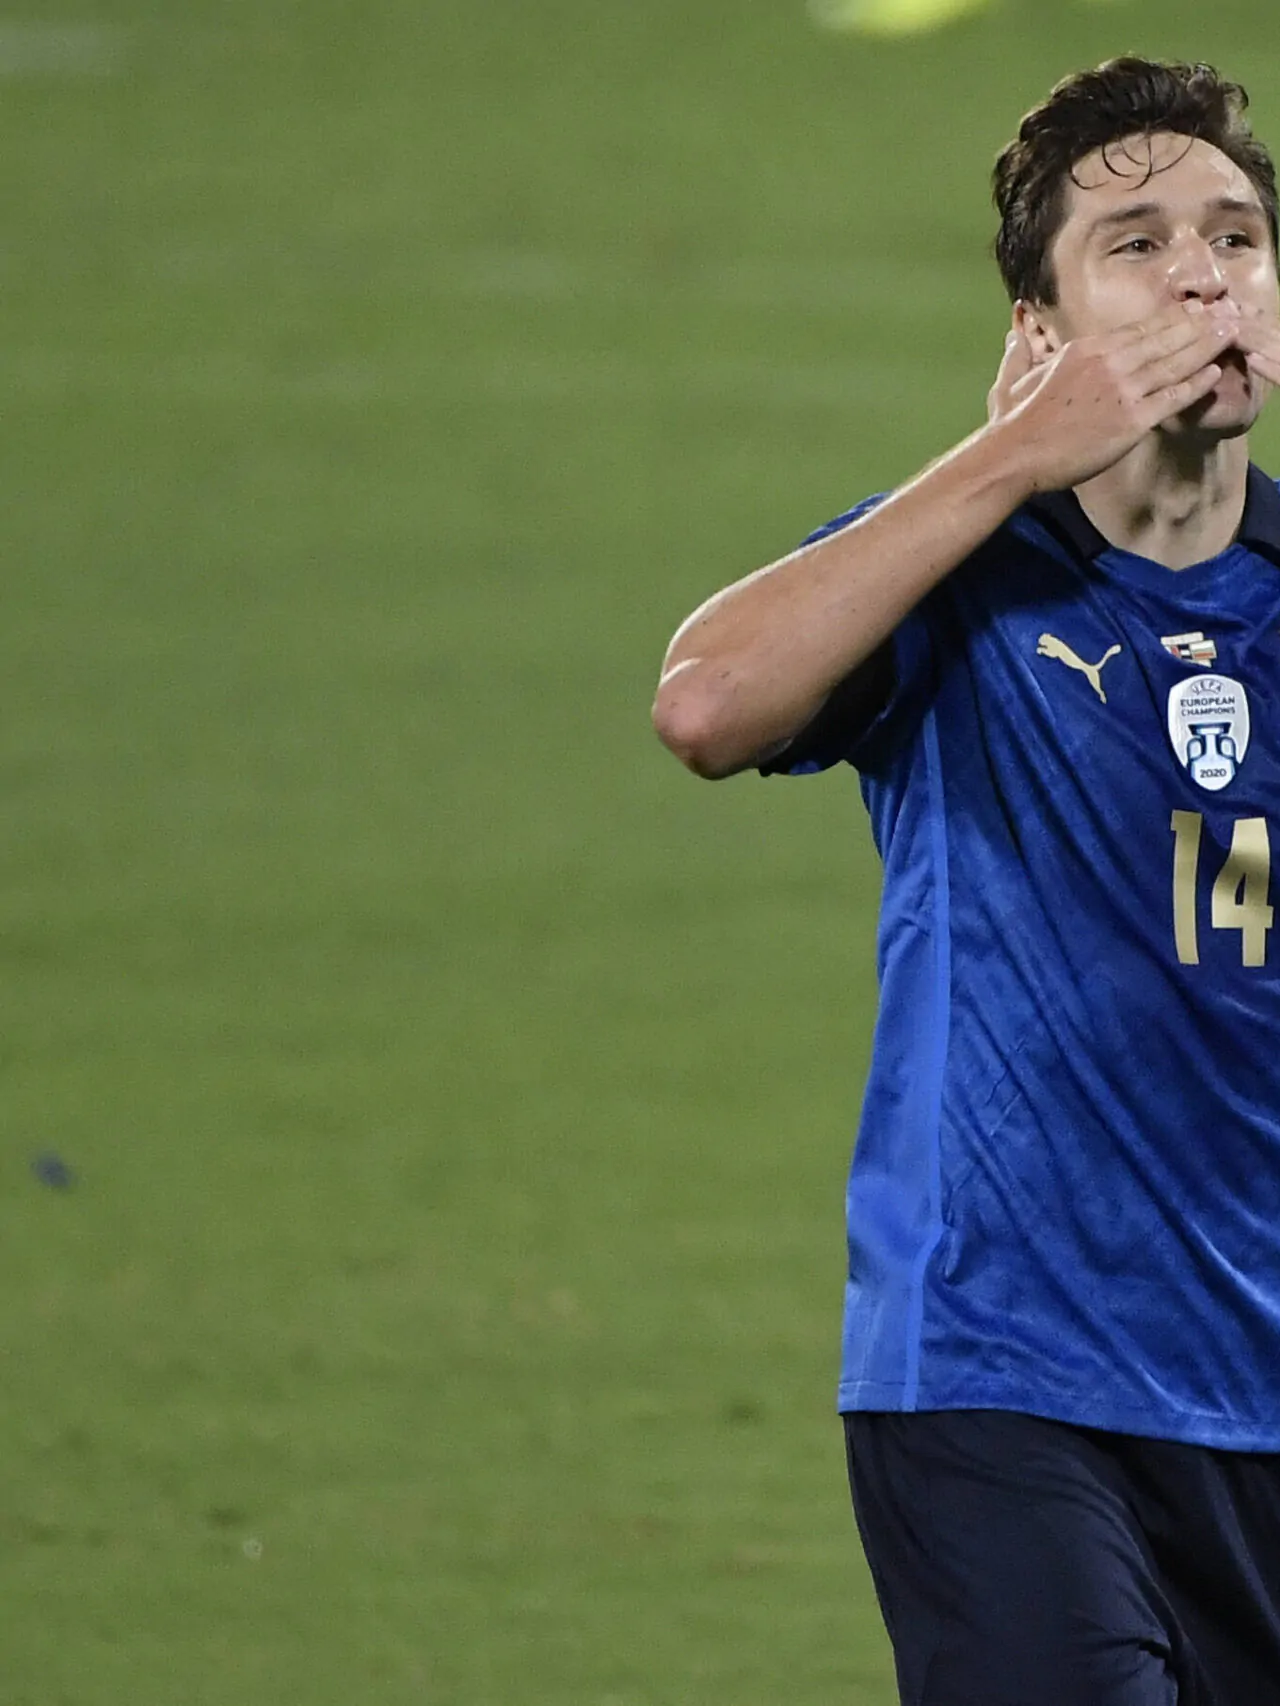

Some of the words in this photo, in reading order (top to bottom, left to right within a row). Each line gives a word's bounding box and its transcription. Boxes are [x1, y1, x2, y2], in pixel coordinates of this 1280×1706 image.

[1192, 680, 1223, 695] UEFA
[1180, 696, 1236, 707] EUROPEAN
[1181, 706, 1236, 717] CHAMPIONS
[1200, 767, 1228, 779] 2020
[1171, 809, 1274, 967] 14
